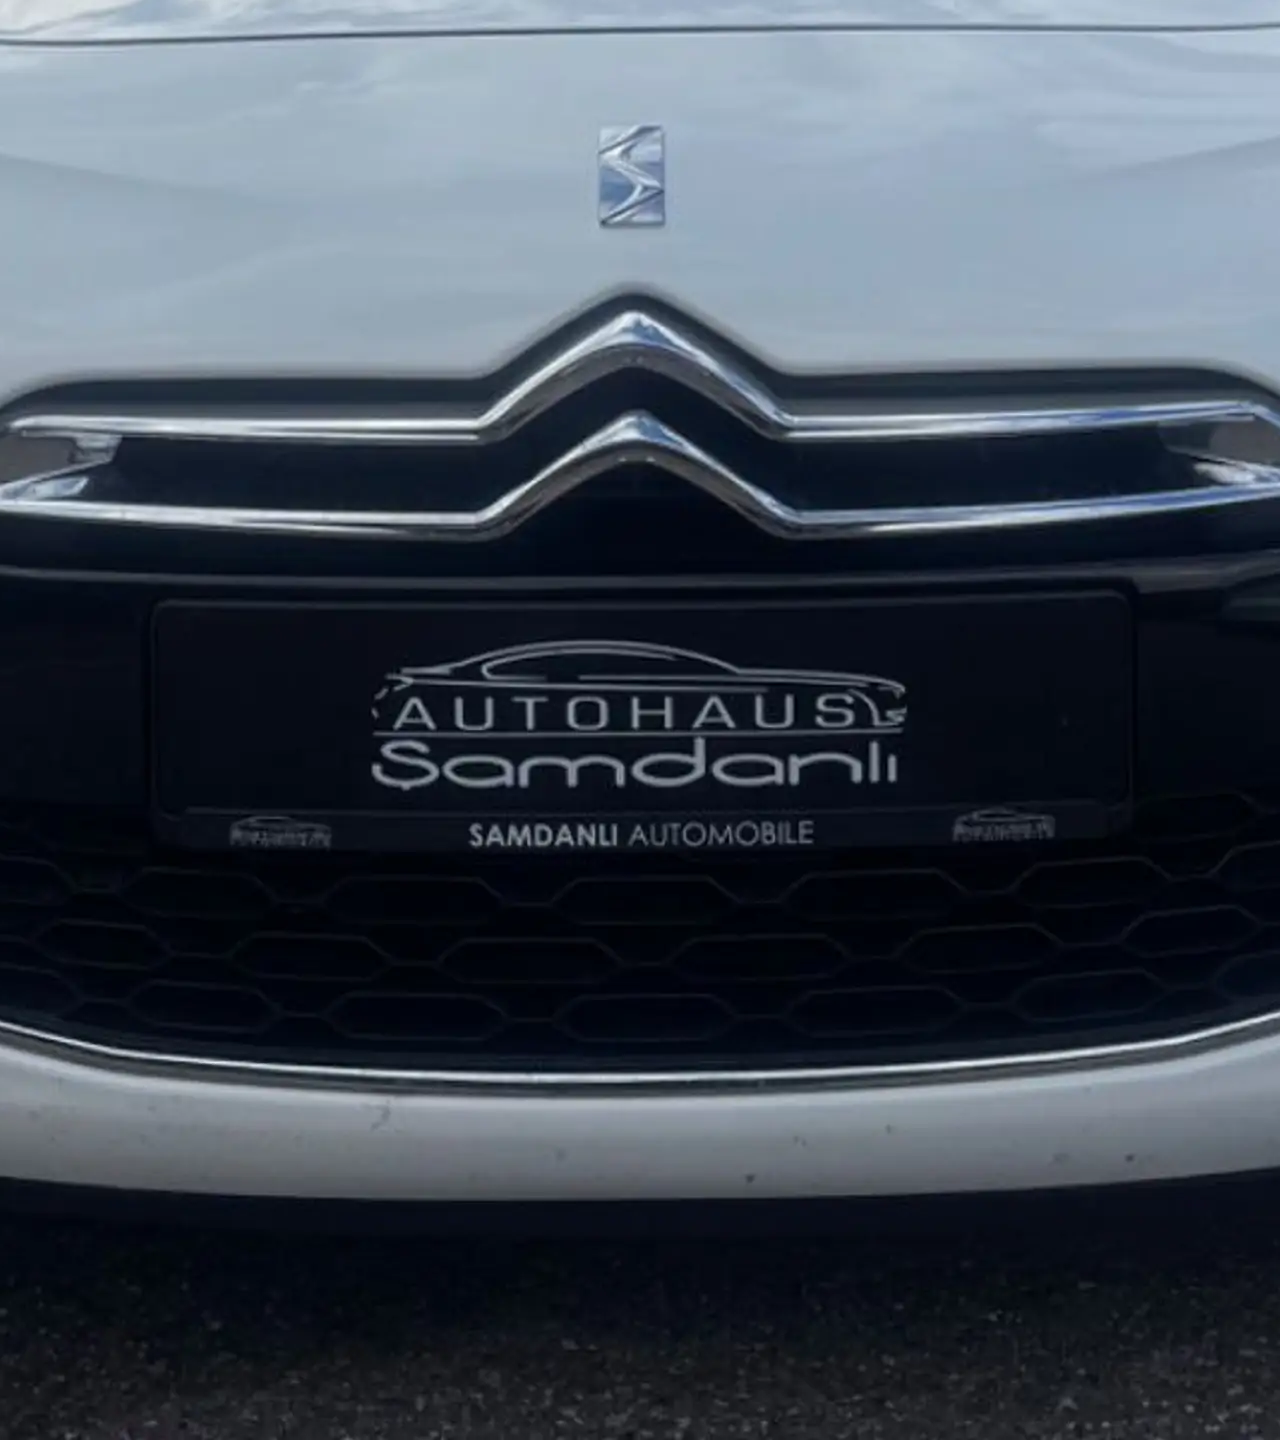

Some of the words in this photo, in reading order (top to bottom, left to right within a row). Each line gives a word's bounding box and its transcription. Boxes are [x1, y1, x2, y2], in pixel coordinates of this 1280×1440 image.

[393, 693, 857, 731] AUTOHAUS
[468, 823, 619, 848] SAMDANLI
[627, 820, 815, 847] AUTOMOBILE
